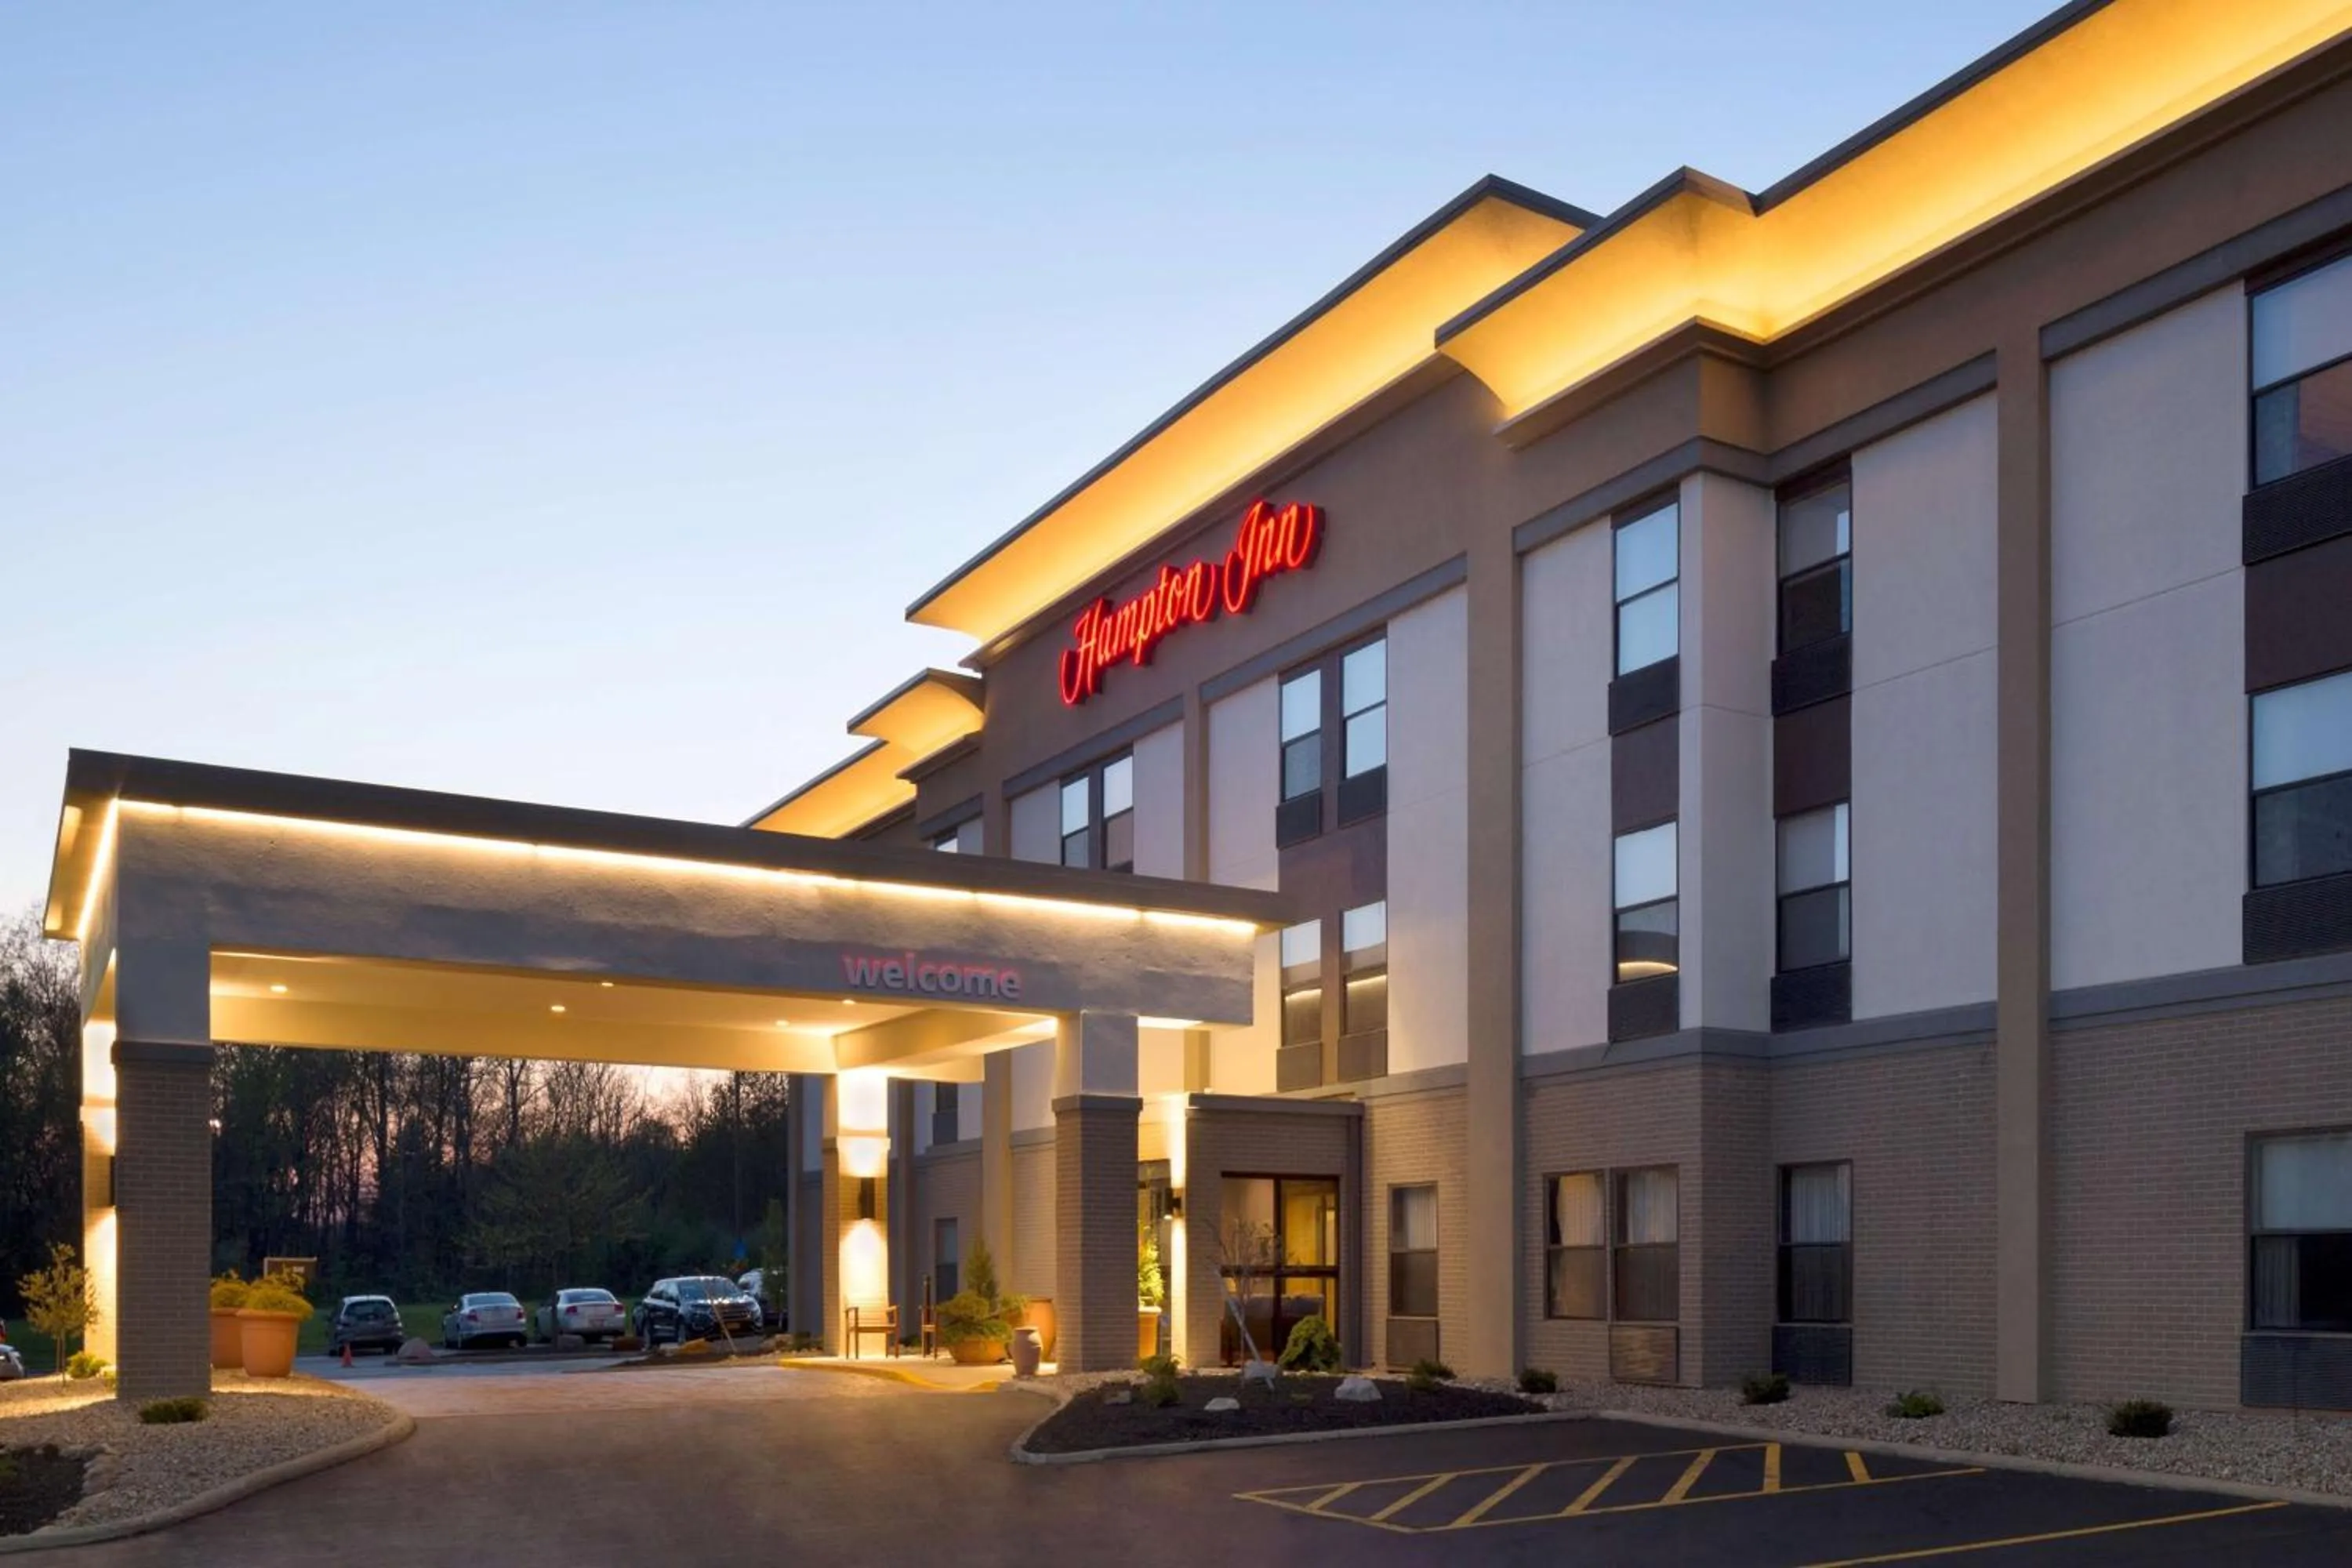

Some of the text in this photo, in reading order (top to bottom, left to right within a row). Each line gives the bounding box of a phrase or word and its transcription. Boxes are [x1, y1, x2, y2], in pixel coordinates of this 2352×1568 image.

[1059, 499, 1317, 706] Hampton Inn
[841, 951, 1023, 1000] welcome
